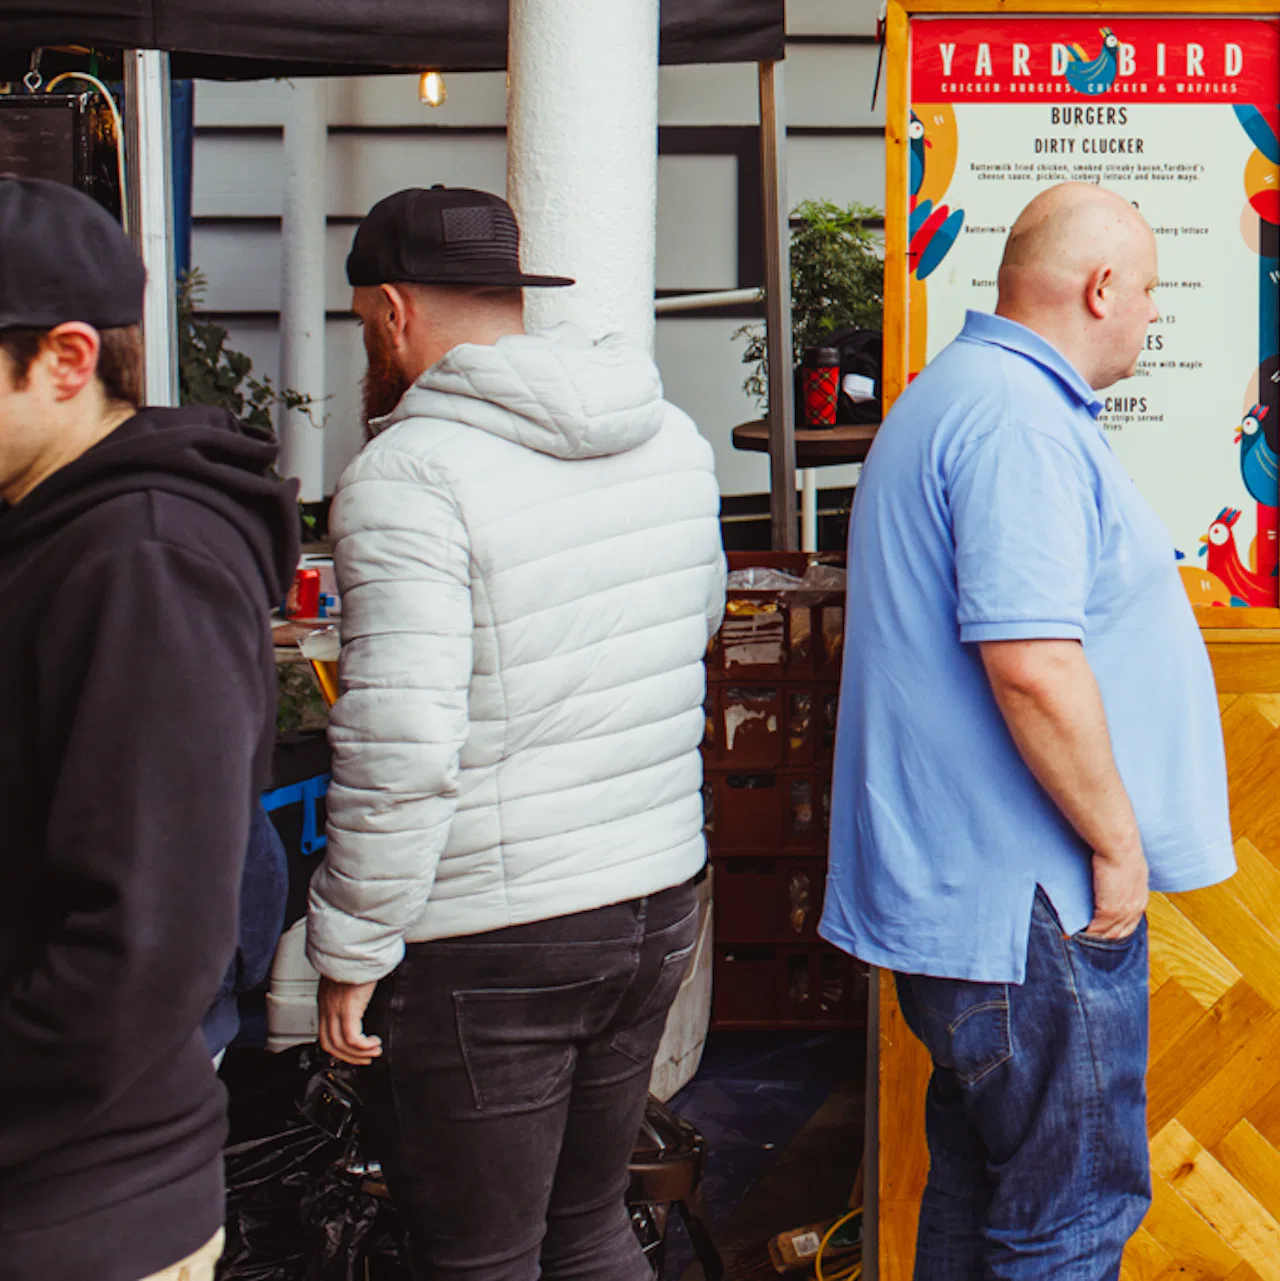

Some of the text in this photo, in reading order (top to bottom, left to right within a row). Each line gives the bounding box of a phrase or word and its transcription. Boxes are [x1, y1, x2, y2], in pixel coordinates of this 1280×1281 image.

[940, 43, 1242, 76] YARD BIRD
[942, 84, 1236, 92] CHICKEN BURGERS, CHICKEN & WAFFLES
[1051, 107, 1127, 125] BURGERS
[1035, 138, 1143, 154] DIRTY CLUCKER
[970, 163, 1012, 171] Buttermilk
[1015, 163, 1031, 171] fried
[1073, 163, 1102, 171] smoked
[1105, 163, 1134, 173] streaky
[966, 225, 1006, 233] Buttermilk
[1181, 226, 1209, 234] lettuce
[1179, 361, 1202, 370] maple
[1105, 396, 1147, 413] CHIPS
[1111, 414, 1134, 423] strips
[1137, 414, 1164, 422] served
